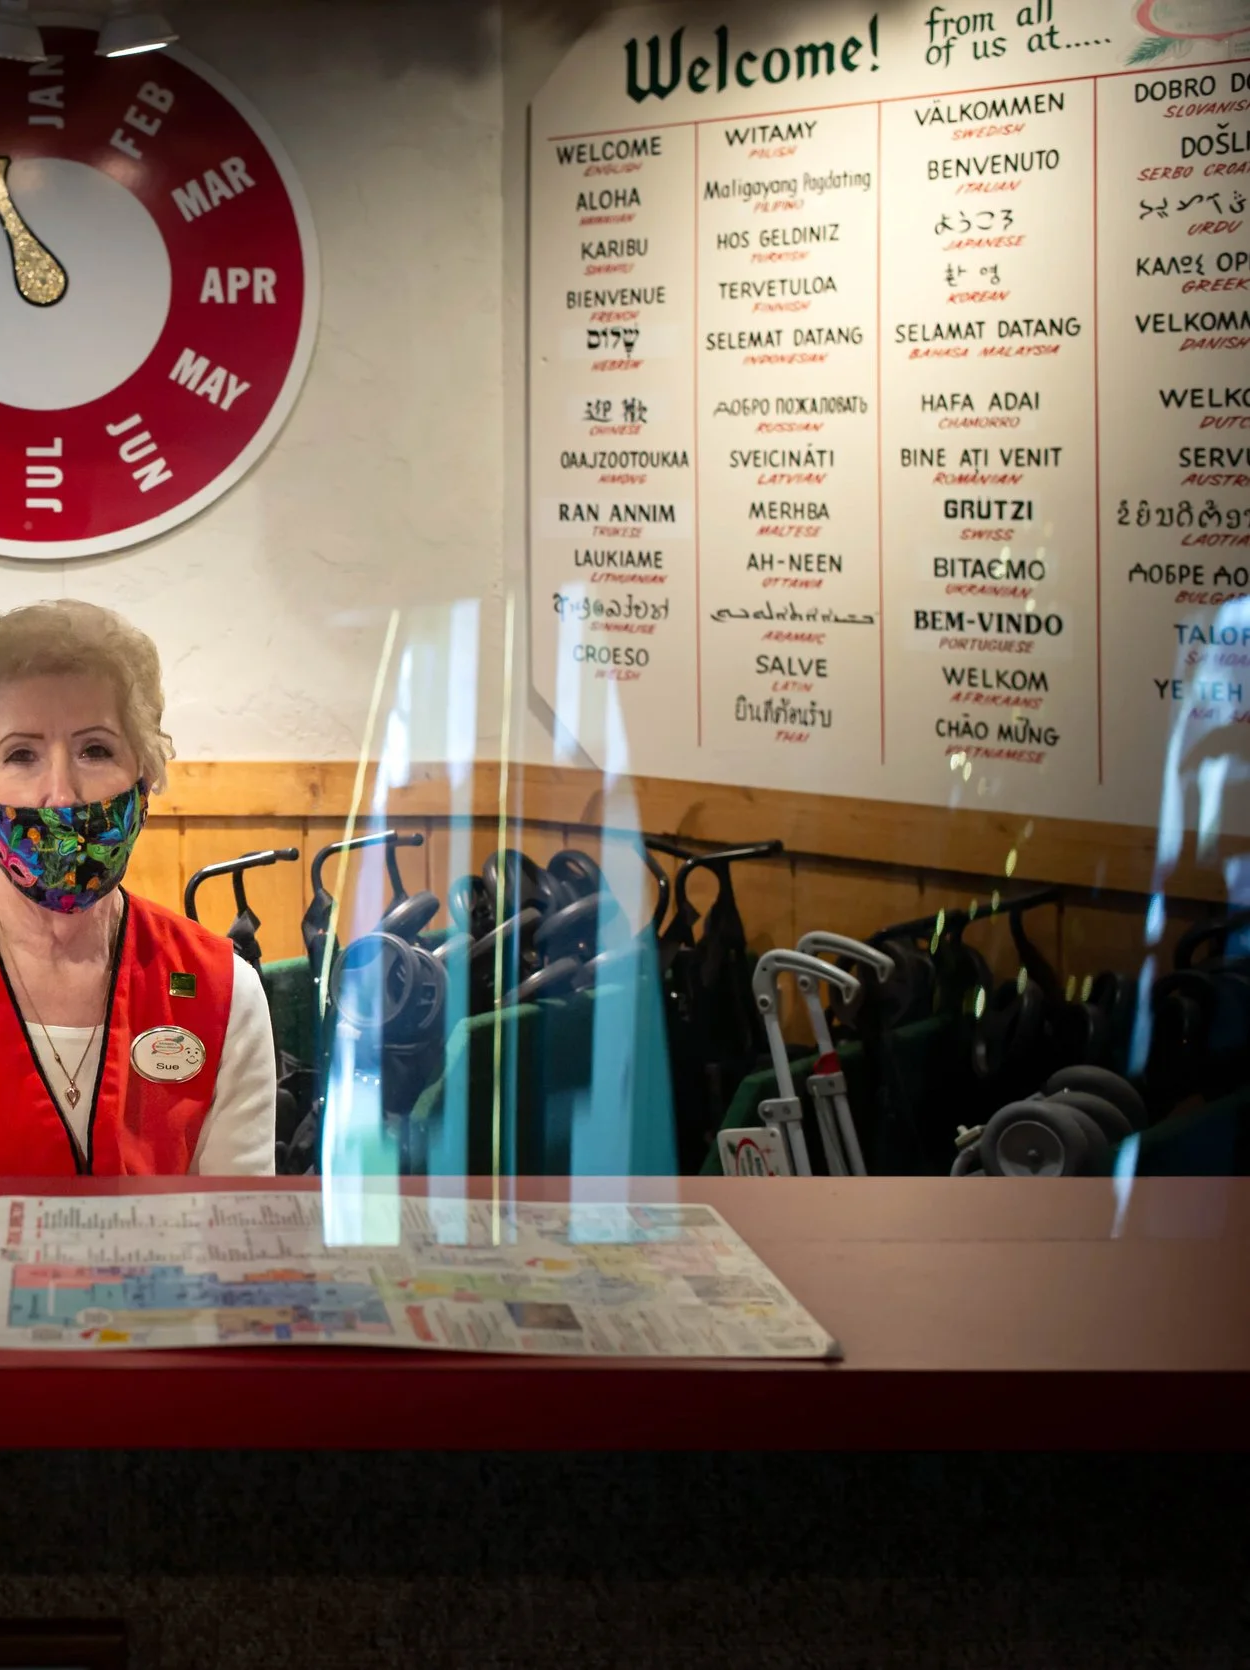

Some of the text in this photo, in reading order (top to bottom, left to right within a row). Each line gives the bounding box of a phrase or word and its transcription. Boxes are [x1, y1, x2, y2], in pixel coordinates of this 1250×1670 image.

[925, 0, 1052, 43] from all
[623, 11, 880, 104] Welcome!
[925, 37, 958, 69] of
[972, 36, 1008, 61] us
[28, 55, 65, 129] JAN
[1135, 75, 1216, 103] DOBRO
[110, 80, 175, 160] FEB
[914, 92, 1065, 127] VÄLKOMMEN
[724, 120, 818, 147] WITAMY
[951, 123, 1026, 141] SWEDISH
[555, 136, 662, 165] WELCOME
[927, 148, 1061, 181] BENVENUTO
[1137, 165, 1194, 181] SERBO
[170, 156, 257, 223] MAR
[703, 170, 872, 202] Maligayang Pagdating
[955, 180, 1022, 195] ITALIAN
[575, 187, 641, 212] ALOHA
[716, 223, 840, 250] HOS GELDINIZ
[1187, 219, 1244, 236] URDU
[580, 237, 649, 261] KARIBU
[199, 266, 278, 305] APR
[565, 285, 667, 309] BIENVENUE
[718, 275, 837, 300] TERVETULOA
[1181, 277, 1250, 294] GREEK
[705, 326, 864, 351] SELEMAT DATANG
[894, 317, 1082, 344] SELAMAT DATANG
[1179, 336, 1250, 351] DANISH
[168, 347, 252, 412] MAY
[921, 391, 1040, 413] HAFA ADAI
[938, 416, 1022, 430] CHAMORRO
[105, 413, 174, 494] JUN
[900, 448, 947, 468] BINE
[1000, 447, 1063, 467] VENIT
[1179, 447, 1250, 468] SERV
[25, 436, 64, 513] JUL
[558, 503, 676, 522] RAN ANNIM
[748, 501, 830, 520] MERHBA
[959, 528, 1015, 542] SWISS
[574, 549, 663, 569] LAUKIAME
[746, 552, 842, 573] AH-NEEN
[914, 609, 1064, 637] BEM-VINDO
[573, 644, 650, 667] CROESO
[938, 637, 1036, 654] PORTUGUESE
[755, 654, 829, 678] SALVE
[771, 680, 814, 693] LATIN
[942, 666, 1049, 693] WELKOM
[1153, 678, 1183, 700] YE
[949, 691, 1043, 710] AFRIKAANS
